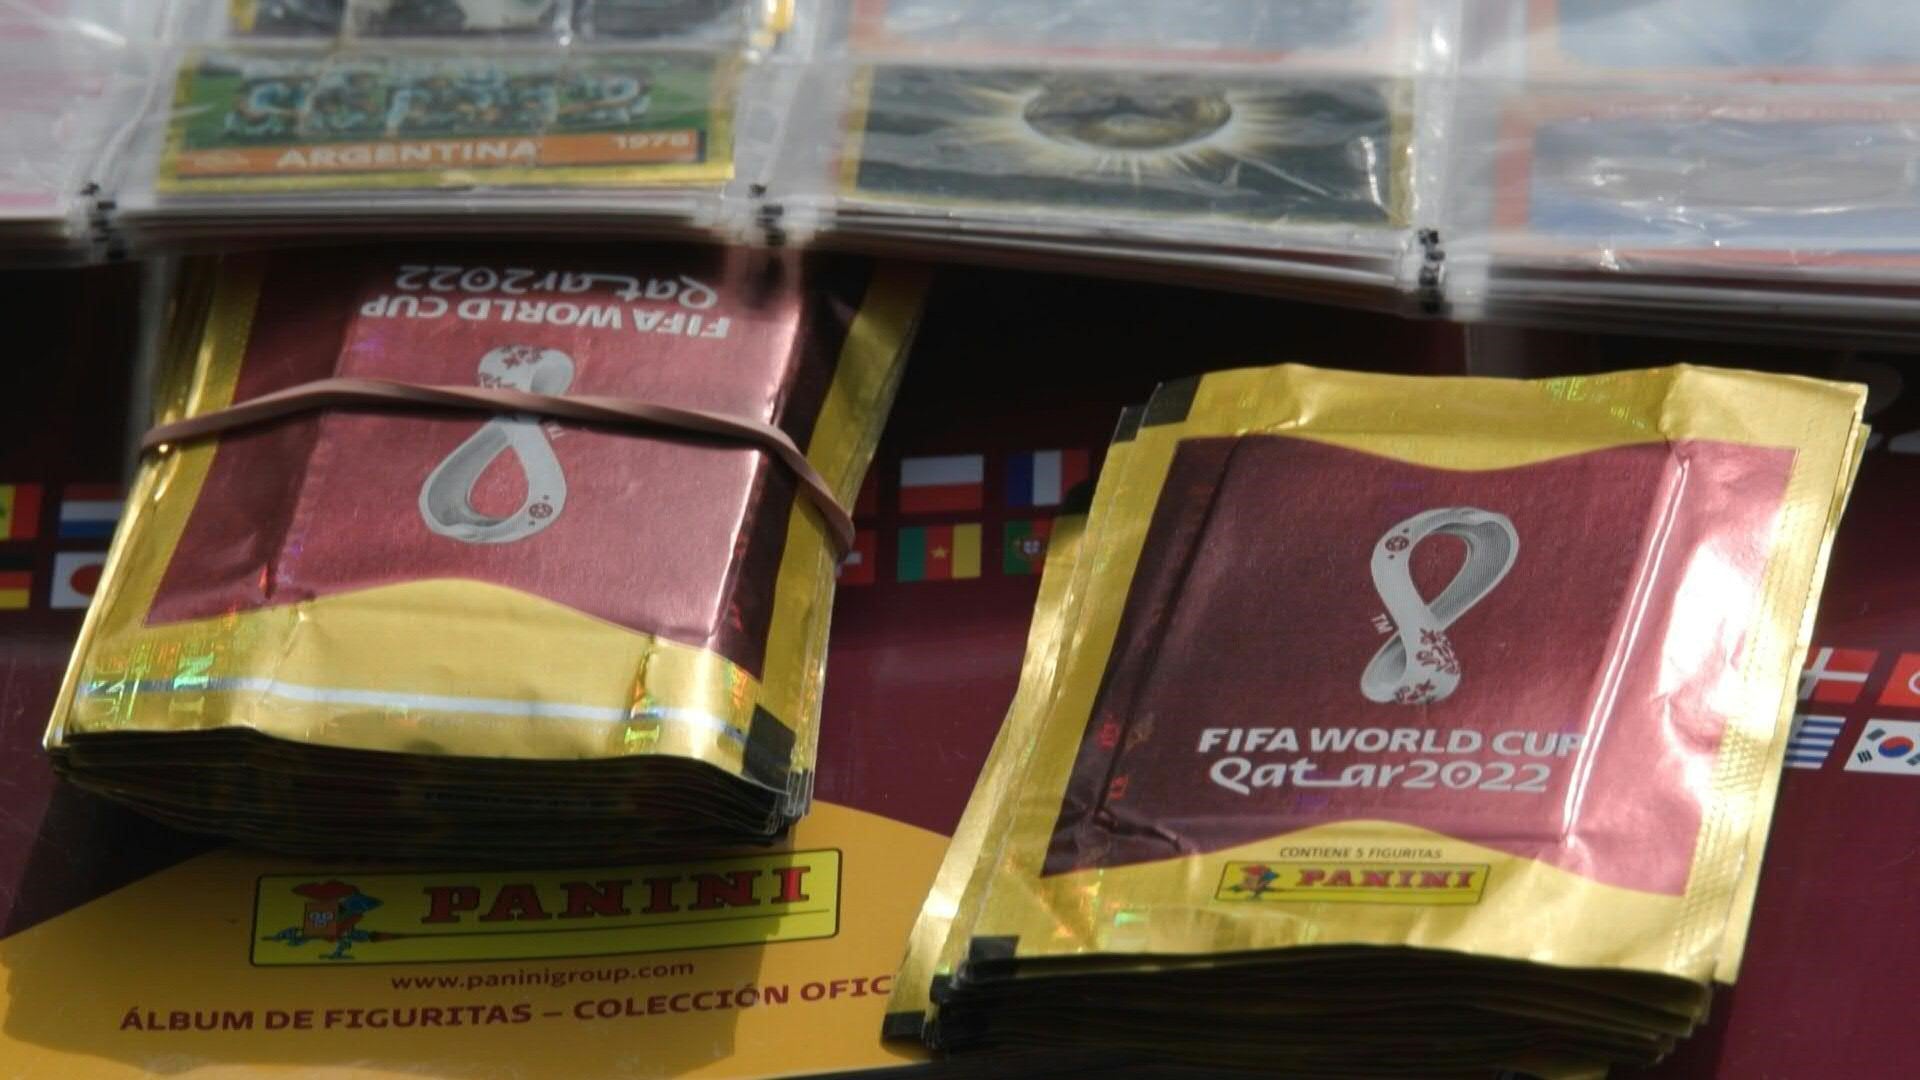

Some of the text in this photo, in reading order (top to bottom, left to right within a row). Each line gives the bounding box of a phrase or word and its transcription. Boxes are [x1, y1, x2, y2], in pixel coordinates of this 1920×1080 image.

[277, 138, 538, 169] ARGENTINA
[360, 295, 732, 339] FIFA WORLD CUP
[1197, 728, 1588, 757] FIFA WORLD CUP
[1279, 846, 1443, 860] CONTIENE 5 FIGURITAS
[1295, 868, 1476, 889] PANINI
[421, 866, 811, 924] PANINI
[391, 961, 695, 990] www.paninigroup.com
[120, 1006, 254, 1031] ÁLBUM
[264, 1009, 314, 1030] DE
[324, 1003, 532, 1030] FIGURITAS
[573, 982, 789, 1020] COLECCIÓN
[800, 975, 896, 1002] OFIC
